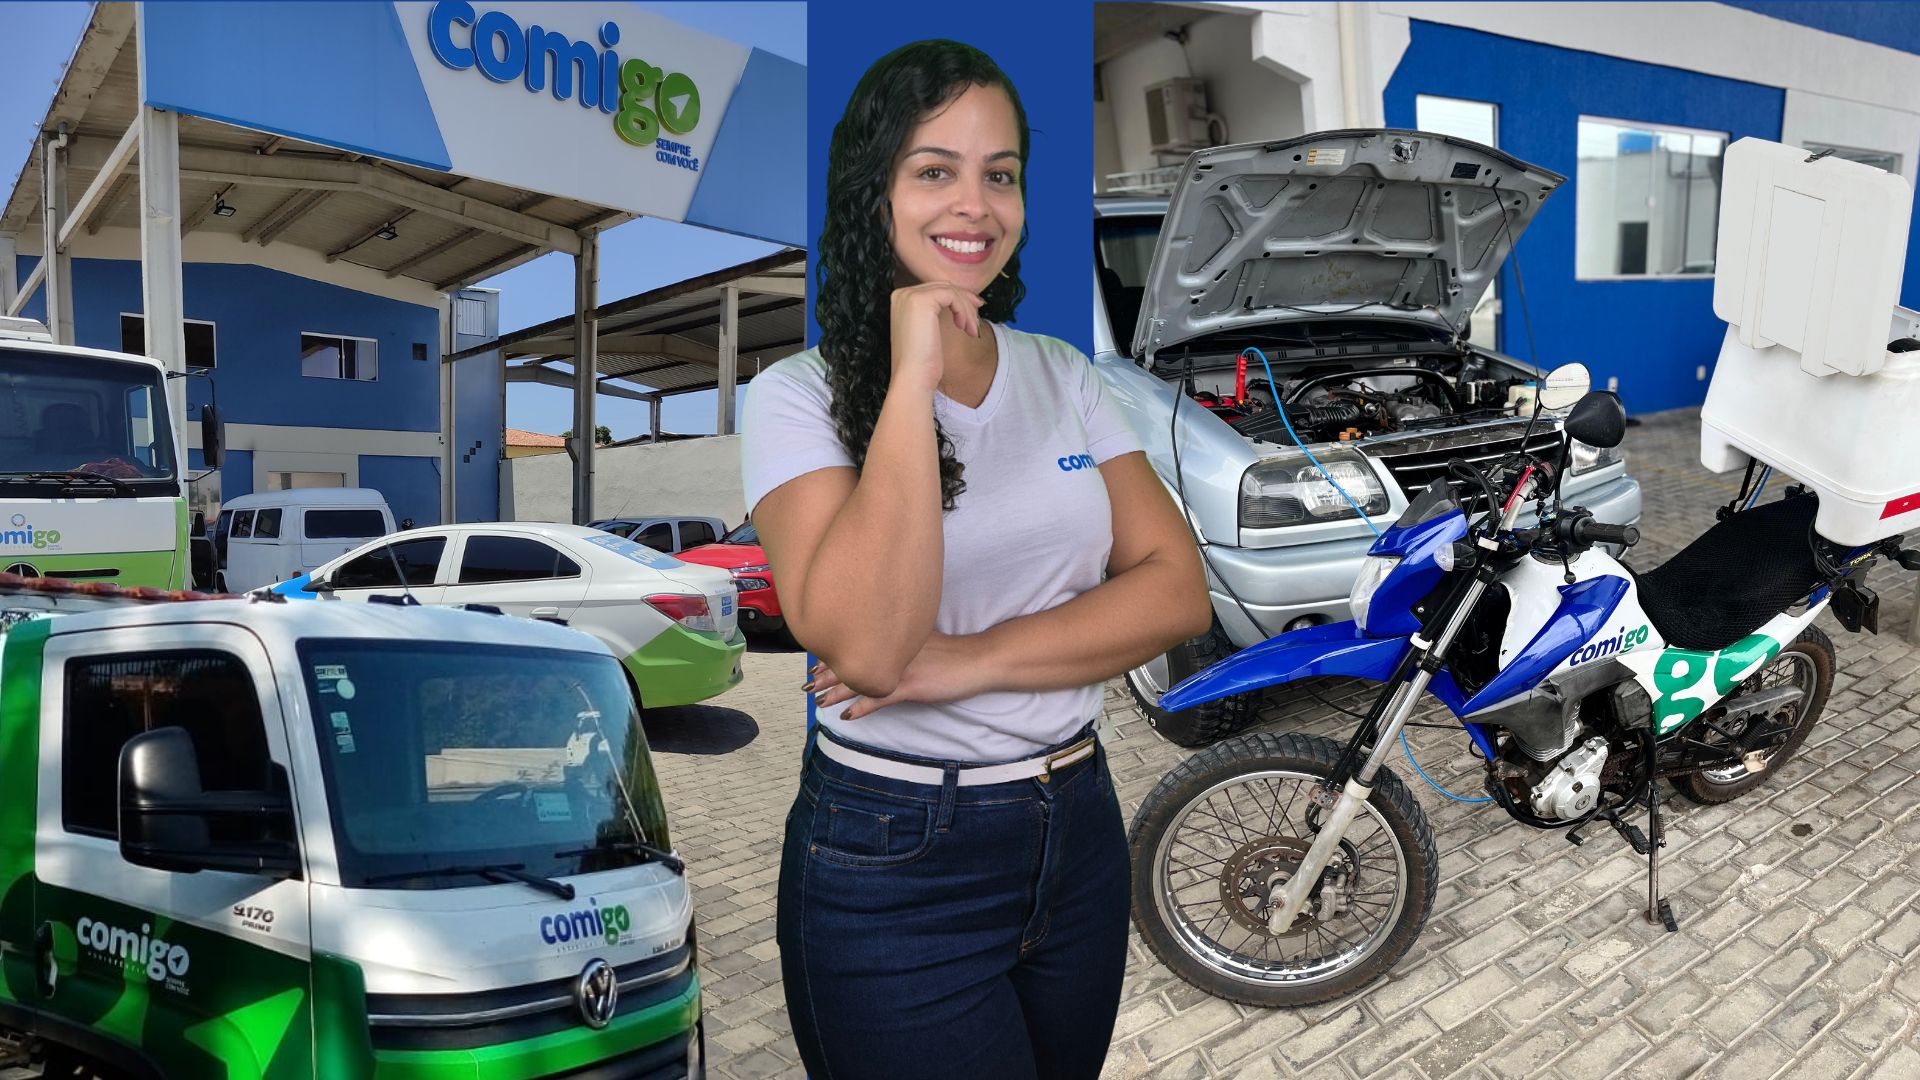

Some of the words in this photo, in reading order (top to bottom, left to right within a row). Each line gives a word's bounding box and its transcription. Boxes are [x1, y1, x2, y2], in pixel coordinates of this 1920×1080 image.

[428, 0, 700, 146] comigo
[656, 138, 691, 157] SEMPRE
[656, 151, 677, 166] COM
[677, 156, 699, 172] VOCÊ
[0, 525, 61, 549] migo
[1569, 624, 1649, 667] comigo
[540, 897, 630, 945] comigo
[77, 916, 189, 981] comigo
